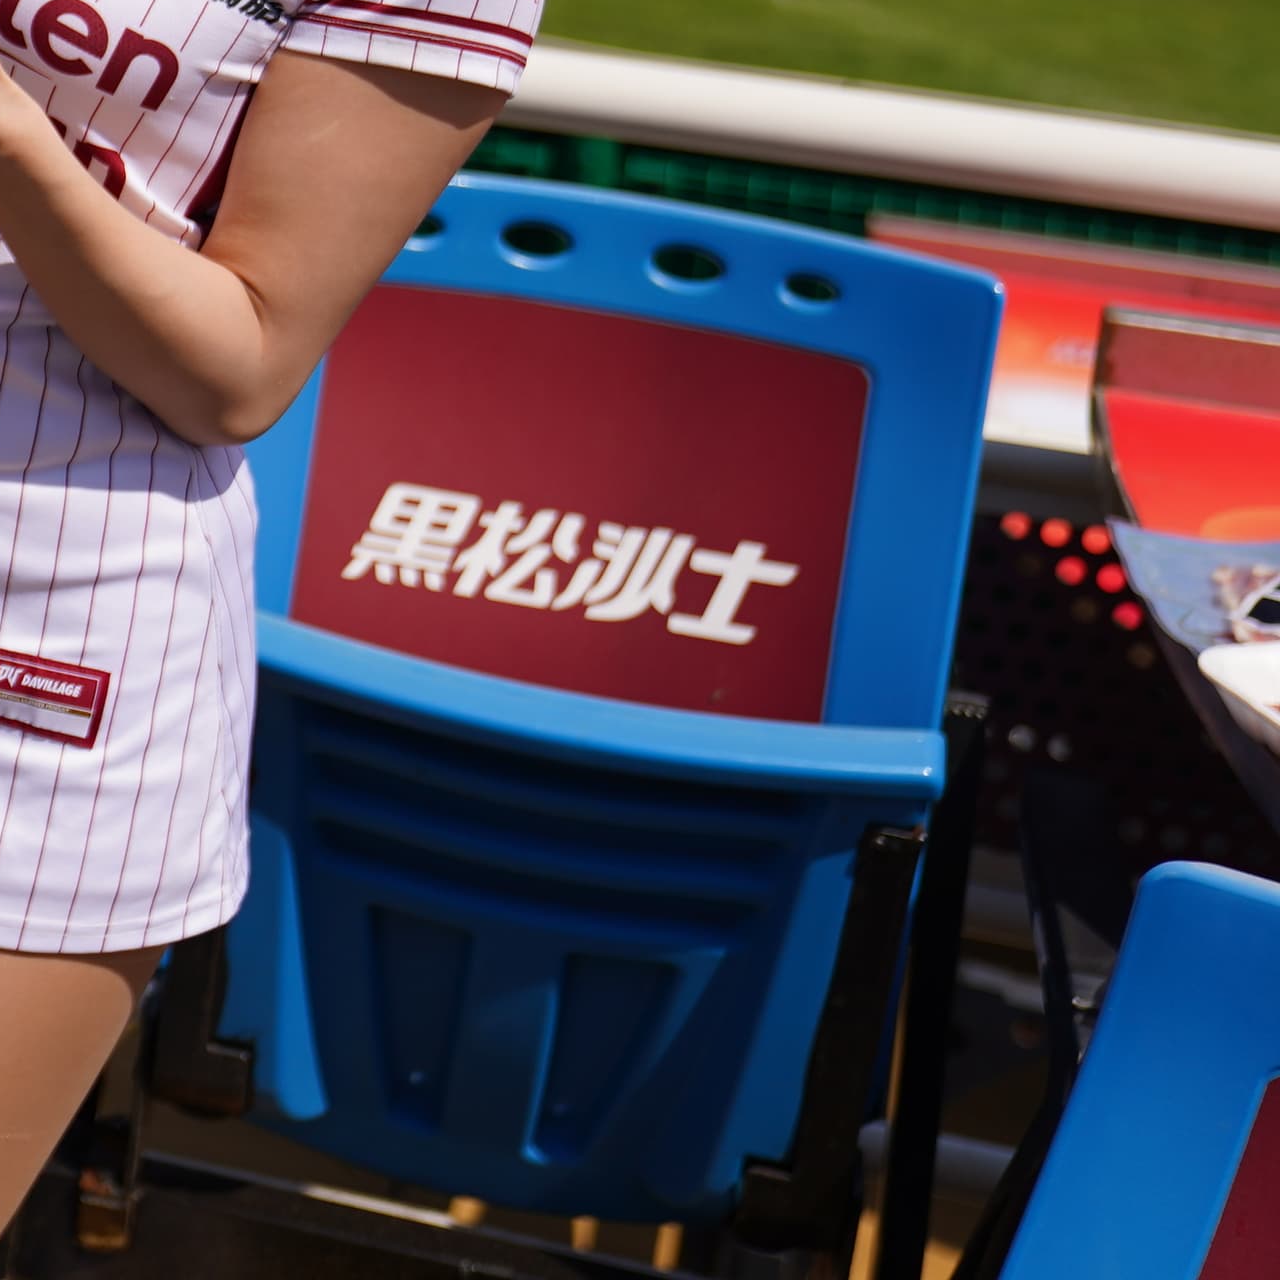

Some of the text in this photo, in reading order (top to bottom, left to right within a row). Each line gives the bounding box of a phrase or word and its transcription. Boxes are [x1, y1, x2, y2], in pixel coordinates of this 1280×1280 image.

[341, 482, 800, 646] 黑松沙士
[21, 673, 83, 698] DAVILLAGE
